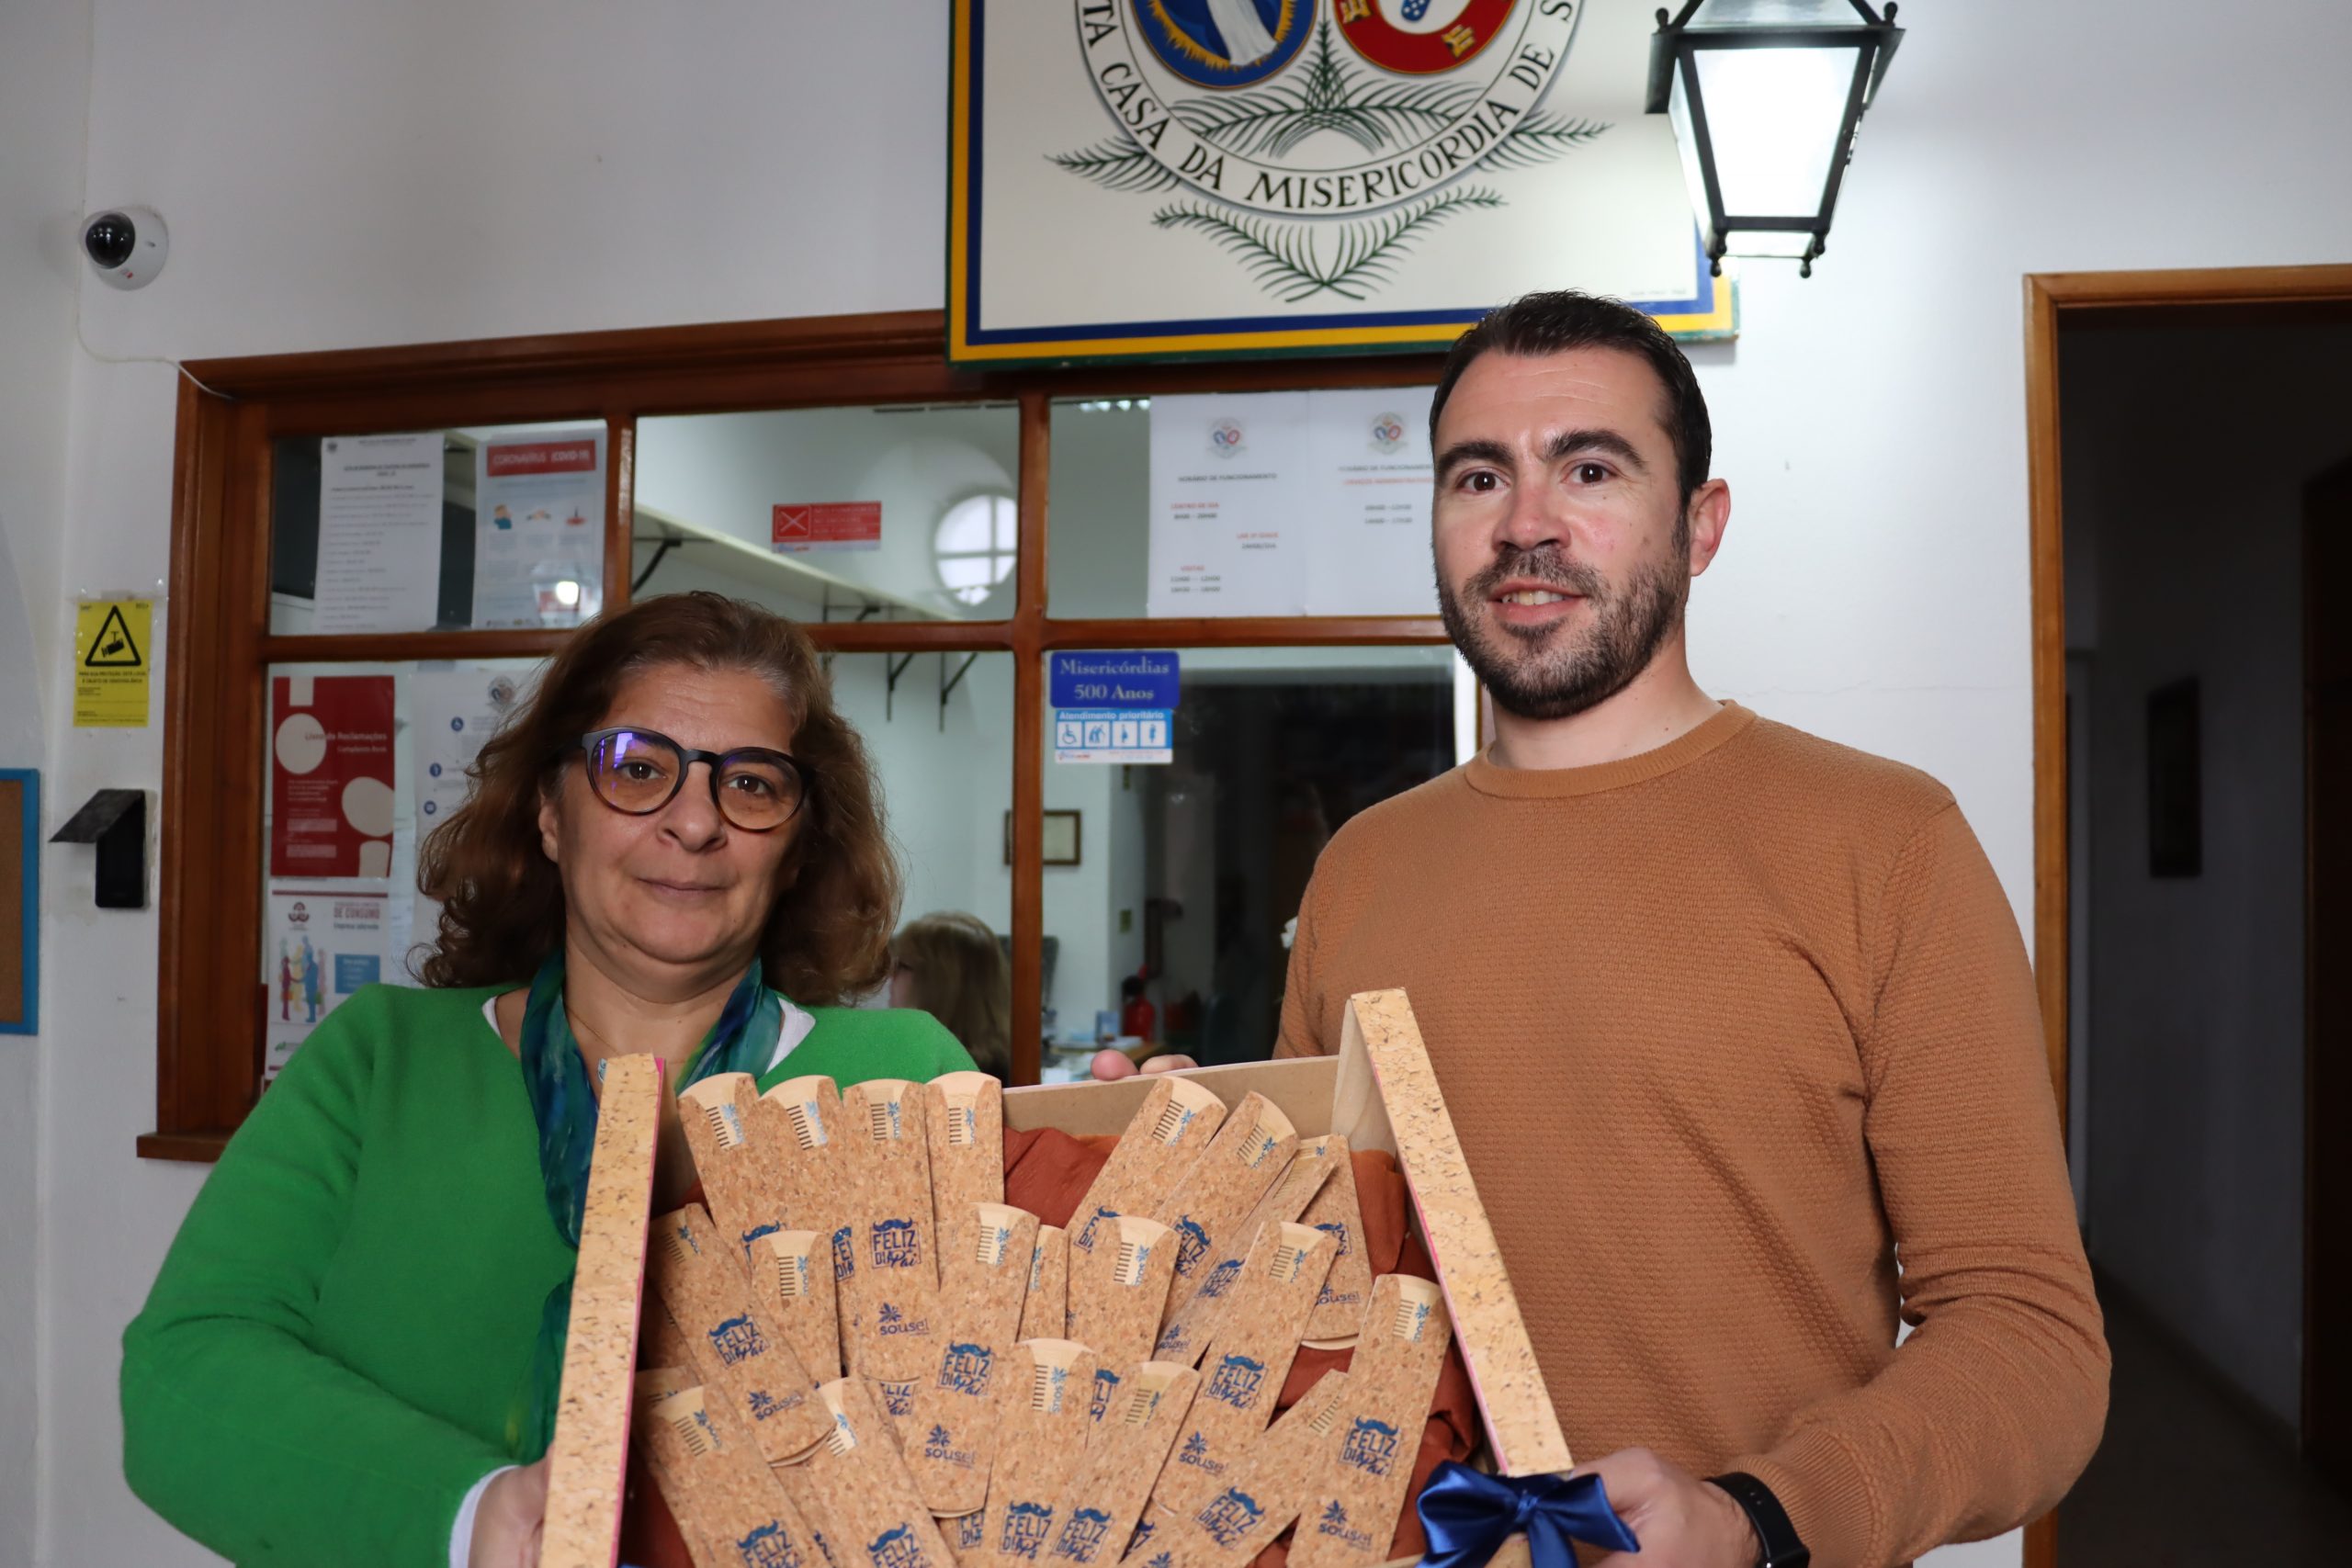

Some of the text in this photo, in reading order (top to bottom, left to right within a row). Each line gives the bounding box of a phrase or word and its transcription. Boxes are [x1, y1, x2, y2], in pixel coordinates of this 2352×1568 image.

[1100, 62, 1170, 151] CASA
[1179, 143, 1225, 190] DA
[1245, 98, 1519, 209] MISERICÓRDIA
[1510, 44, 1555, 91] DE
[1059, 657, 1170, 675] Misericórdias
[1074, 683, 1155, 700] 500 Anos
[1058, 710, 1116, 720] Atendimento
[873, 1230, 917, 1251] FELIZ
[714, 1321, 760, 1354] FELIZ
[879, 1318, 930, 1336] sousel
[943, 1353, 990, 1378] FELIZ
[1214, 1364, 1262, 1393] FELIZ
[1347, 1428, 1397, 1458] FELIZ
[924, 1447, 977, 1465] sousel
[1209, 1495, 1257, 1534] FELIZ
[1062, 1518, 1108, 1544] FELIZ
